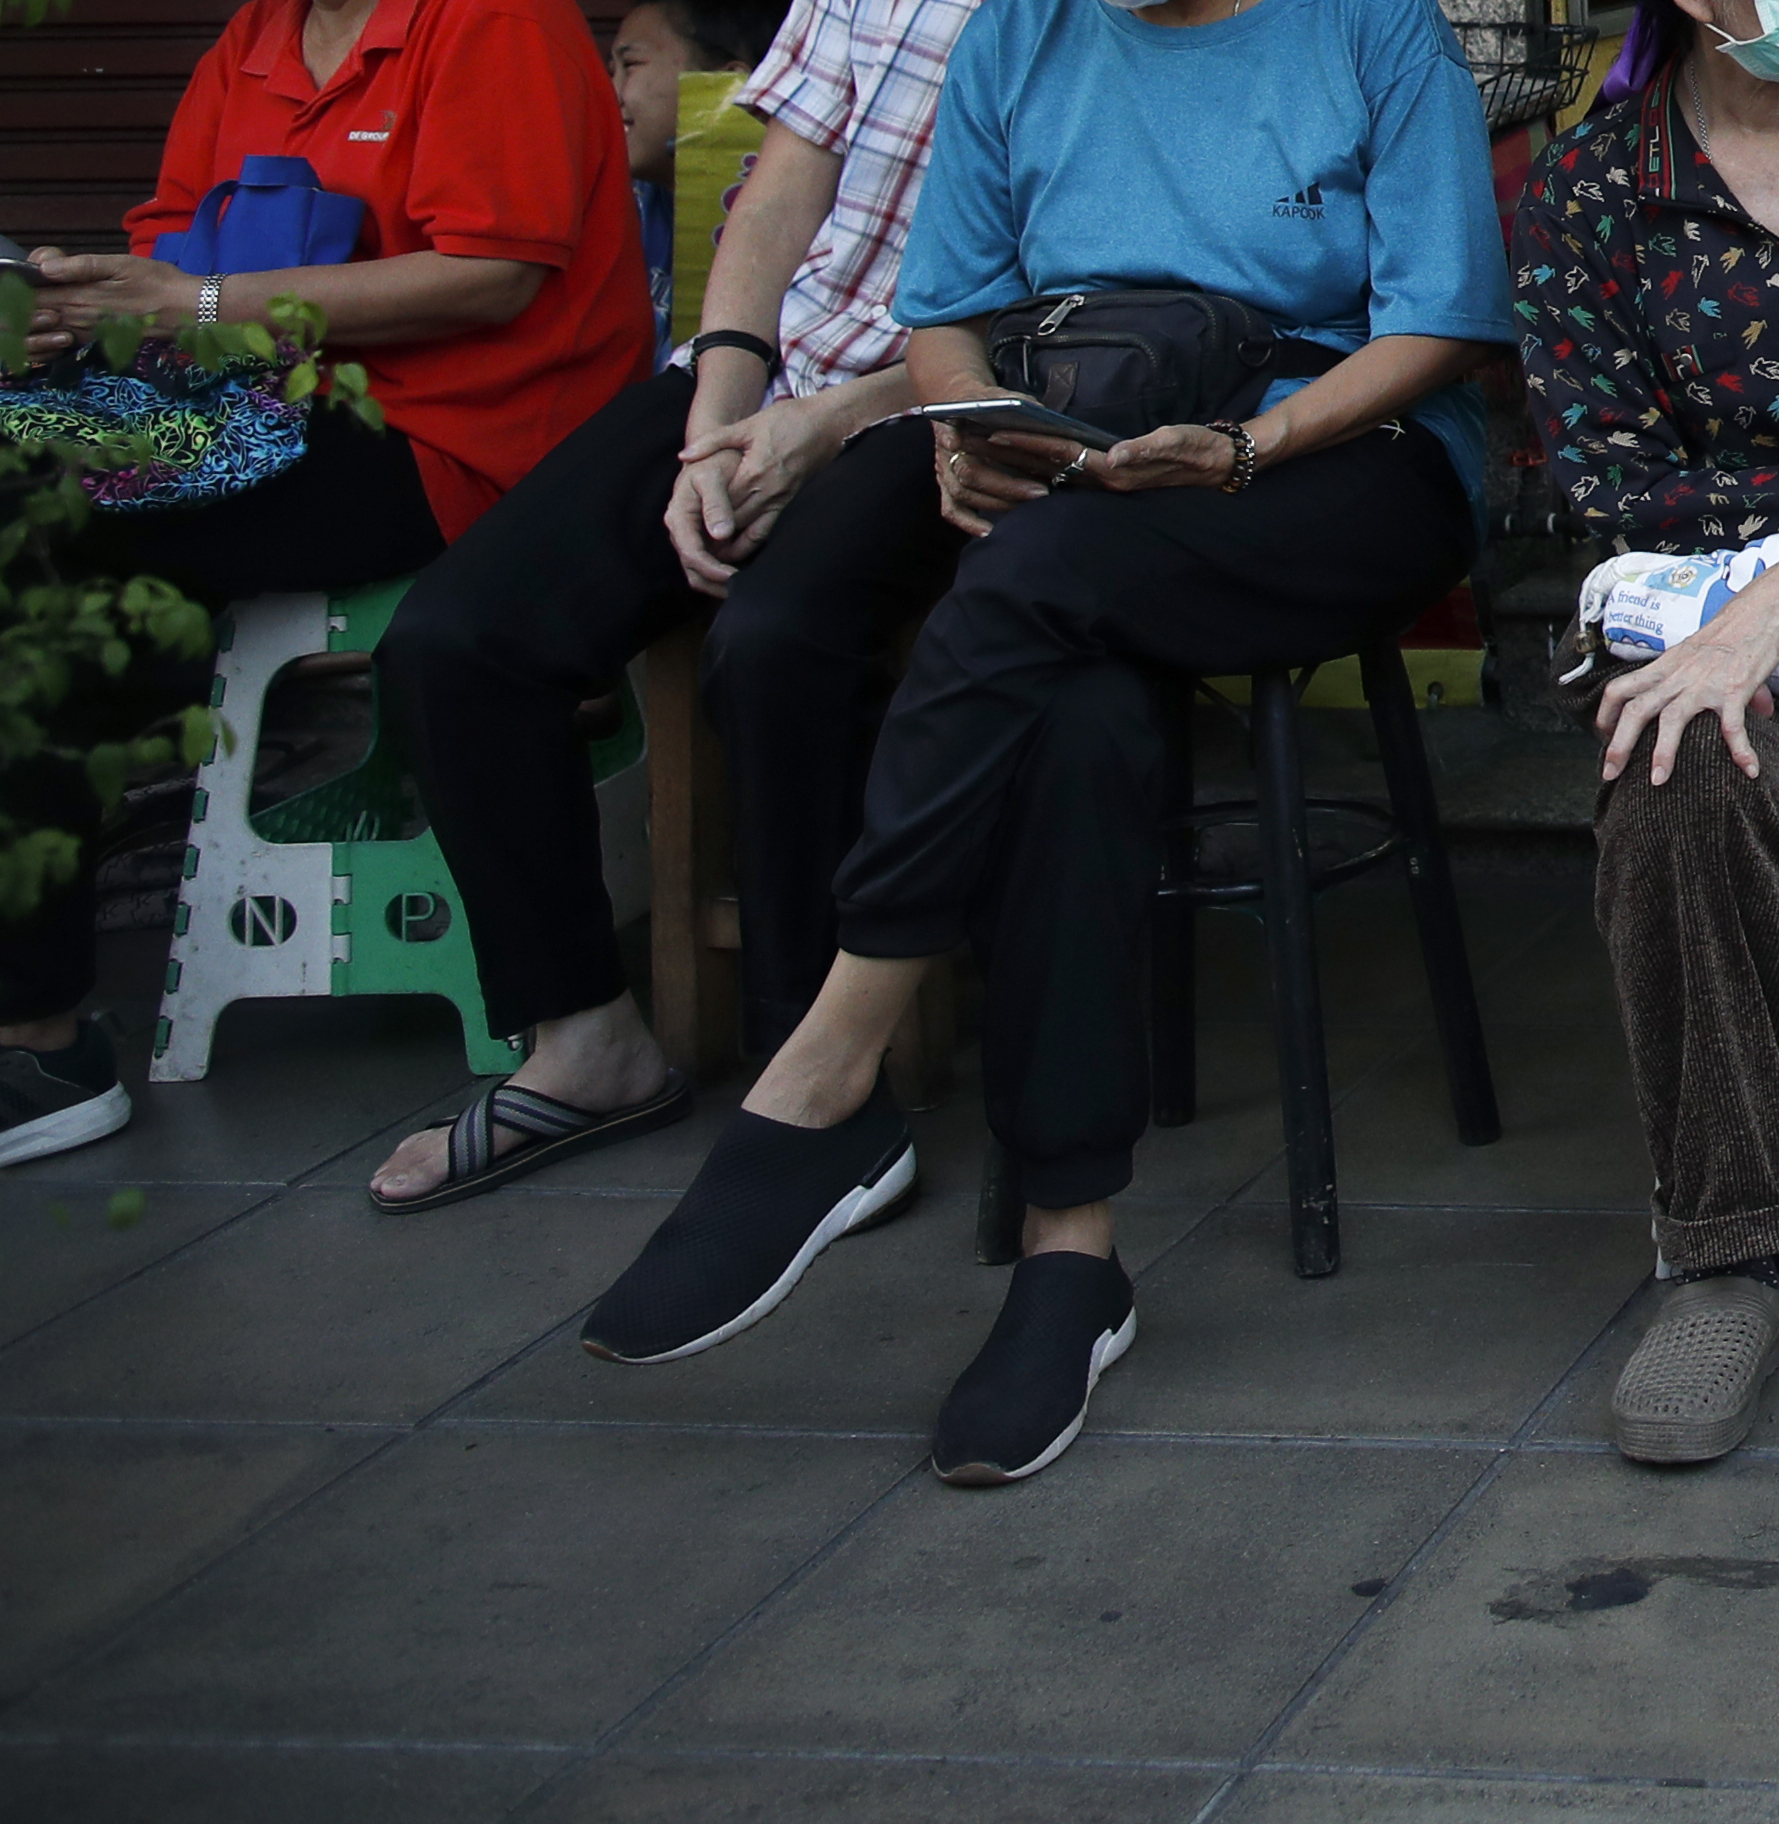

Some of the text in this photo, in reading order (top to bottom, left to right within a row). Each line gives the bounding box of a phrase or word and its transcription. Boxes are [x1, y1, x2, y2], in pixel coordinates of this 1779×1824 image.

[1618, 591, 1649, 607] friend
[1650, 598, 1661, 610] is
[1636, 614, 1664, 636] thing
